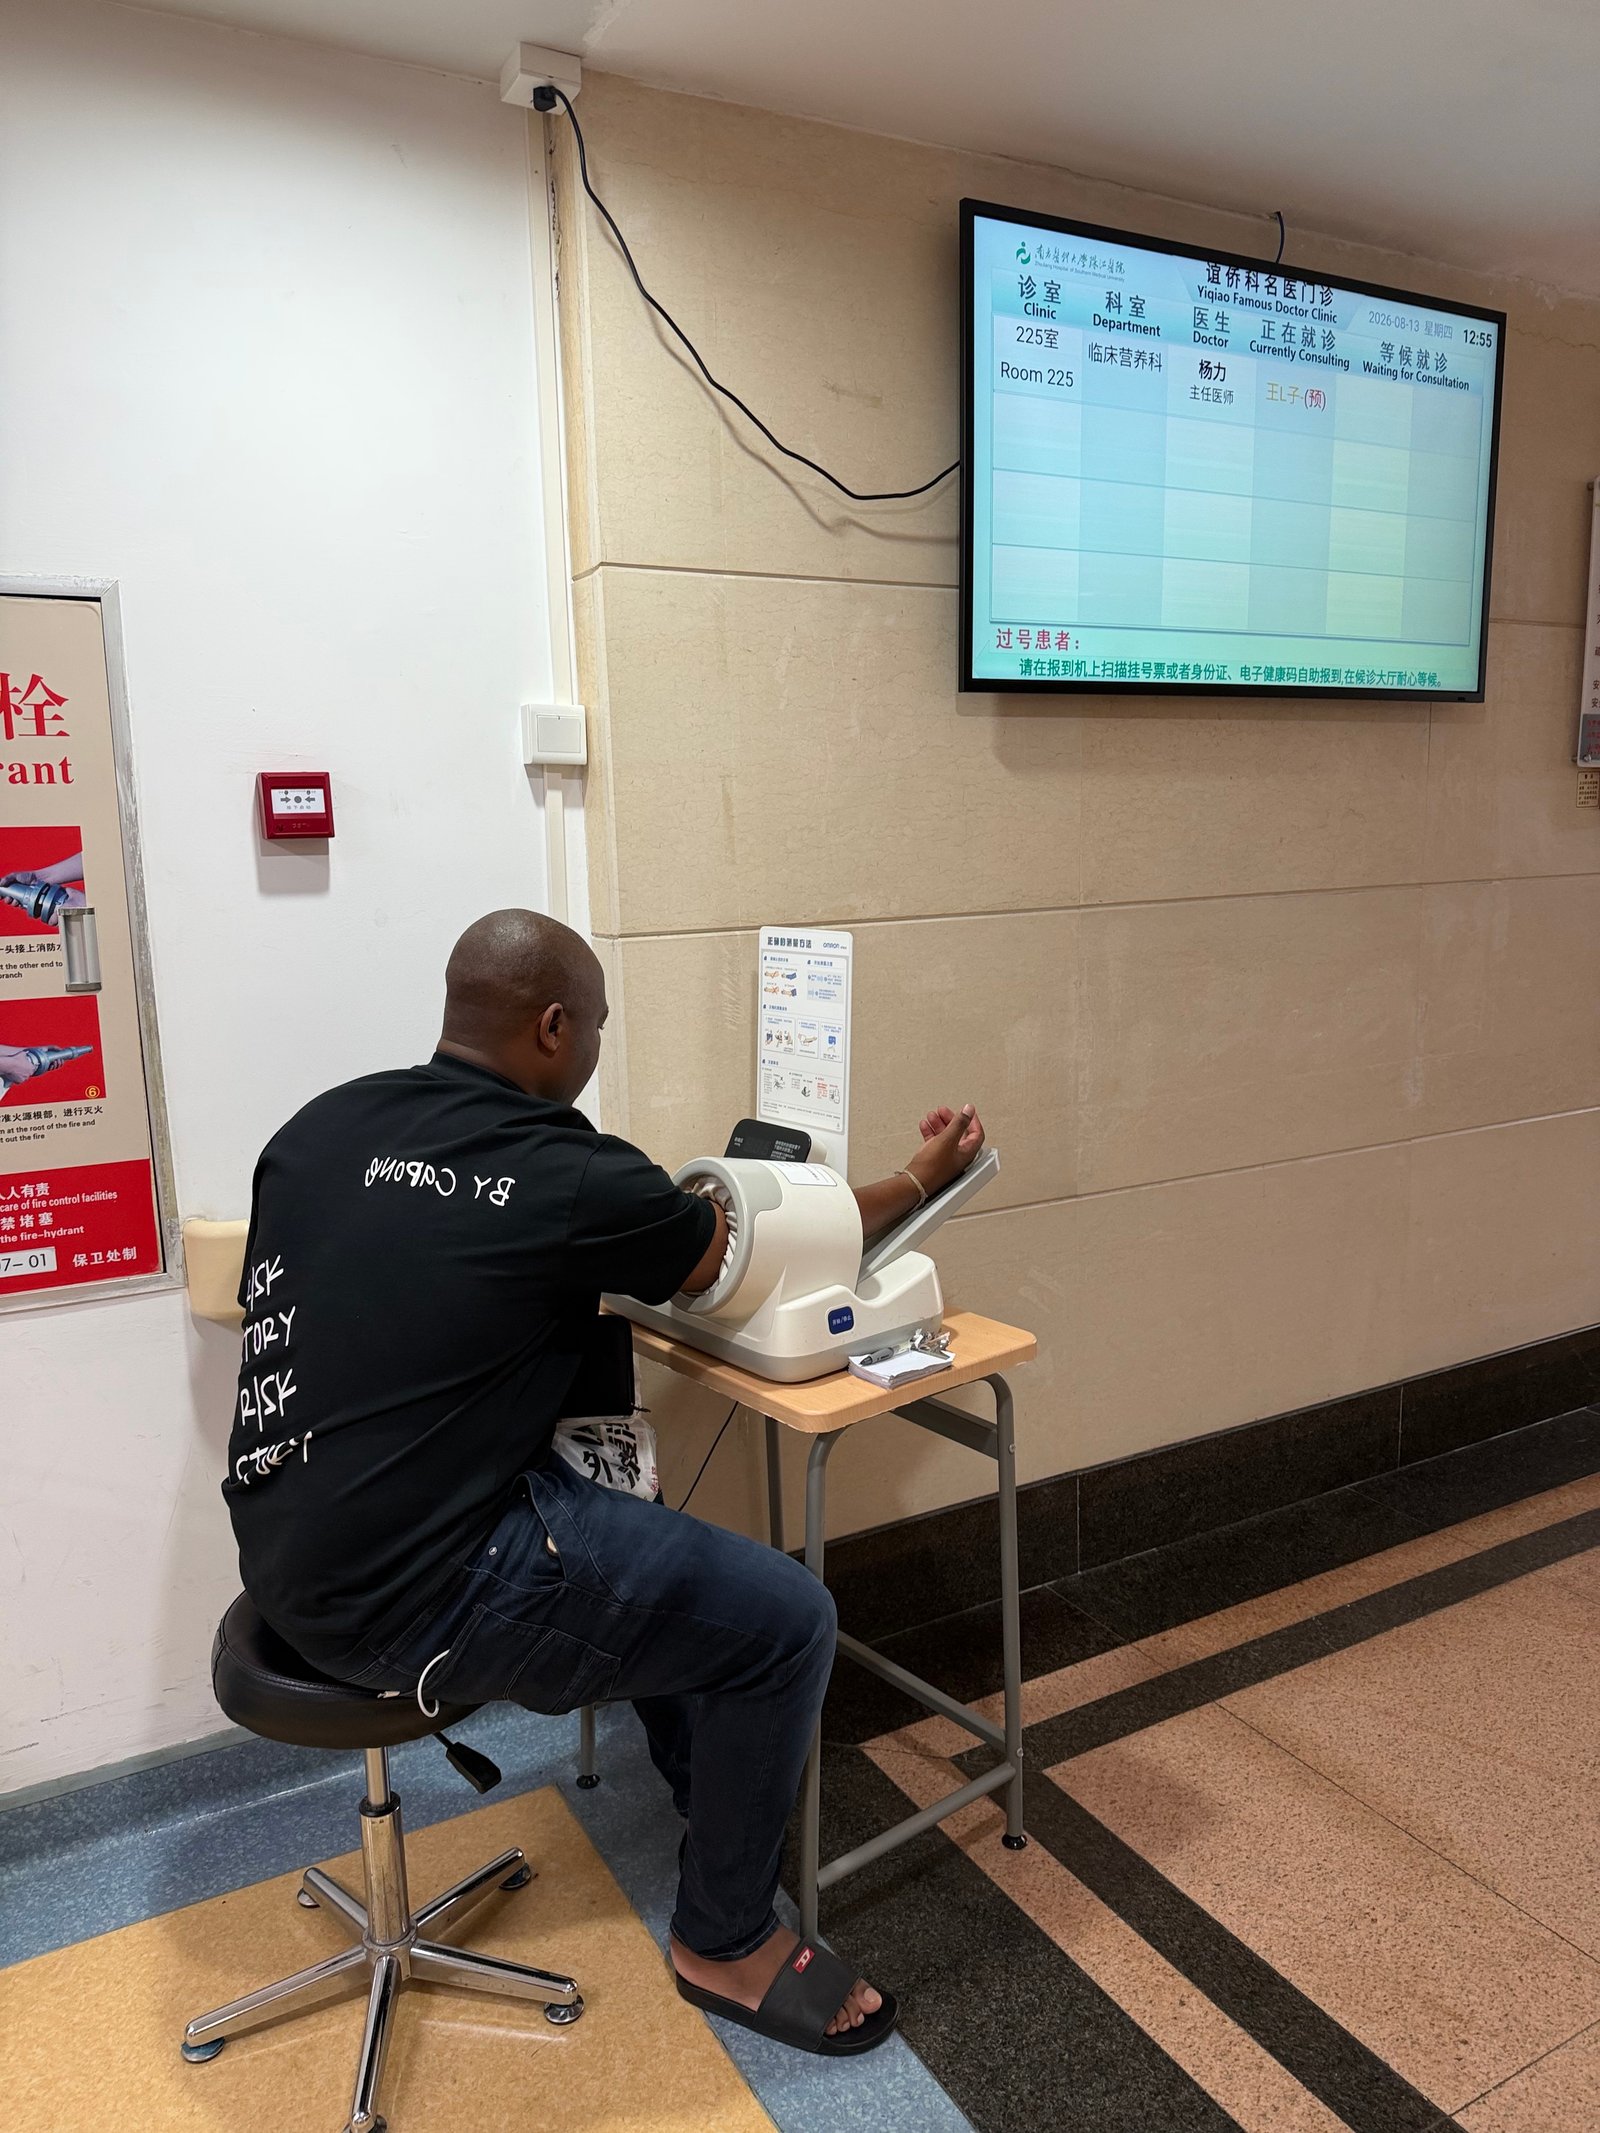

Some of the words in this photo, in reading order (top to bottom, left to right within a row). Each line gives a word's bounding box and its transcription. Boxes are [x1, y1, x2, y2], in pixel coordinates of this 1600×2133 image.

[1017, 274, 1061, 304] 诊室
[1206, 262, 1333, 307] 谊侨科名医门诊
[1024, 302, 1057, 320] Clinic
[1105, 290, 1146, 318] 科室
[1197, 285, 1230, 303] Yiqiao
[1233, 292, 1272, 311] Famous
[1275, 300, 1309, 318] Doctor
[1311, 308, 1337, 323] Clinic
[1093, 313, 1161, 337] Department
[1193, 306, 1230, 334] 医生
[1368, 310, 1420, 332] 2026-08-13
[1463, 329, 1492, 348] 12:55
[1016, 326, 1059, 349] 225室
[1193, 330, 1229, 349] Doctor
[1260, 319, 1336, 351] 正在就诊
[1088, 342, 1162, 372] 临床营养科
[1249, 340, 1296, 362] Currently
[1298, 349, 1350, 372] Consulting
[1380, 341, 1448, 373] 等候就诊
[1001, 361, 1043, 384] Room
[1047, 369, 1074, 387] 225
[1198, 359, 1227, 382] 杨力
[1362, 360, 1398, 381] Waiting
[1400, 367, 1414, 380] for
[1416, 370, 1470, 391] Consultation
[1189, 385, 1234, 404] 主任医师
[0, 672, 70, 740] 栓
[19, 961, 38, 969] other
[69, 1120, 80, 1128] fire
[0, 1202, 19, 1213] care
[21, 1201, 30, 1210] of
[32, 1199, 47, 1208] fire
[49, 1194, 80, 1206] control
[82, 1190, 118, 1202] facilities
[1, 1212, 53, 1231] 禁堵塞
[0, 1234, 17, 1244] the
[72, 1246, 137, 1268] 保卫处制
[240, 1368, 297, 1433] RISK
